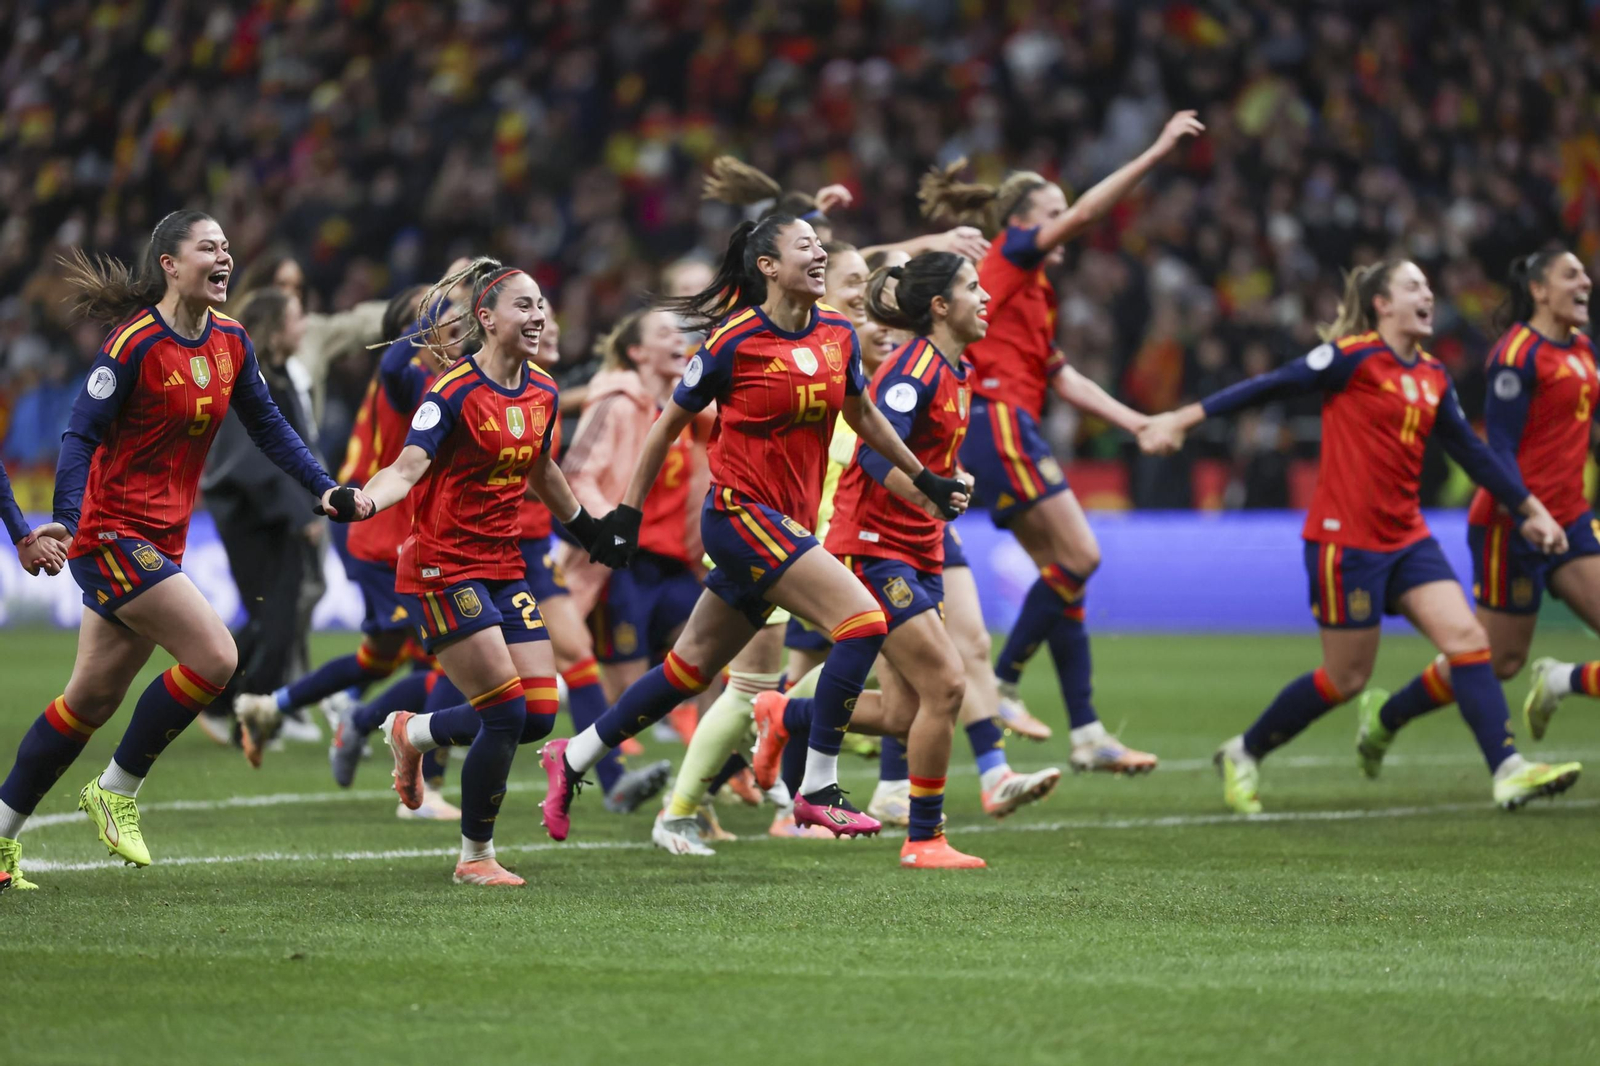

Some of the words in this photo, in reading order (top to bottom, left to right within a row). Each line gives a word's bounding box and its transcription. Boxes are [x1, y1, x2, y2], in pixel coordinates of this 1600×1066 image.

[188, 396, 213, 436] 5
[794, 382, 827, 423] 15
[1400, 405, 1421, 445] 11
[487, 446, 533, 486] 22
[511, 591, 545, 630] 2
